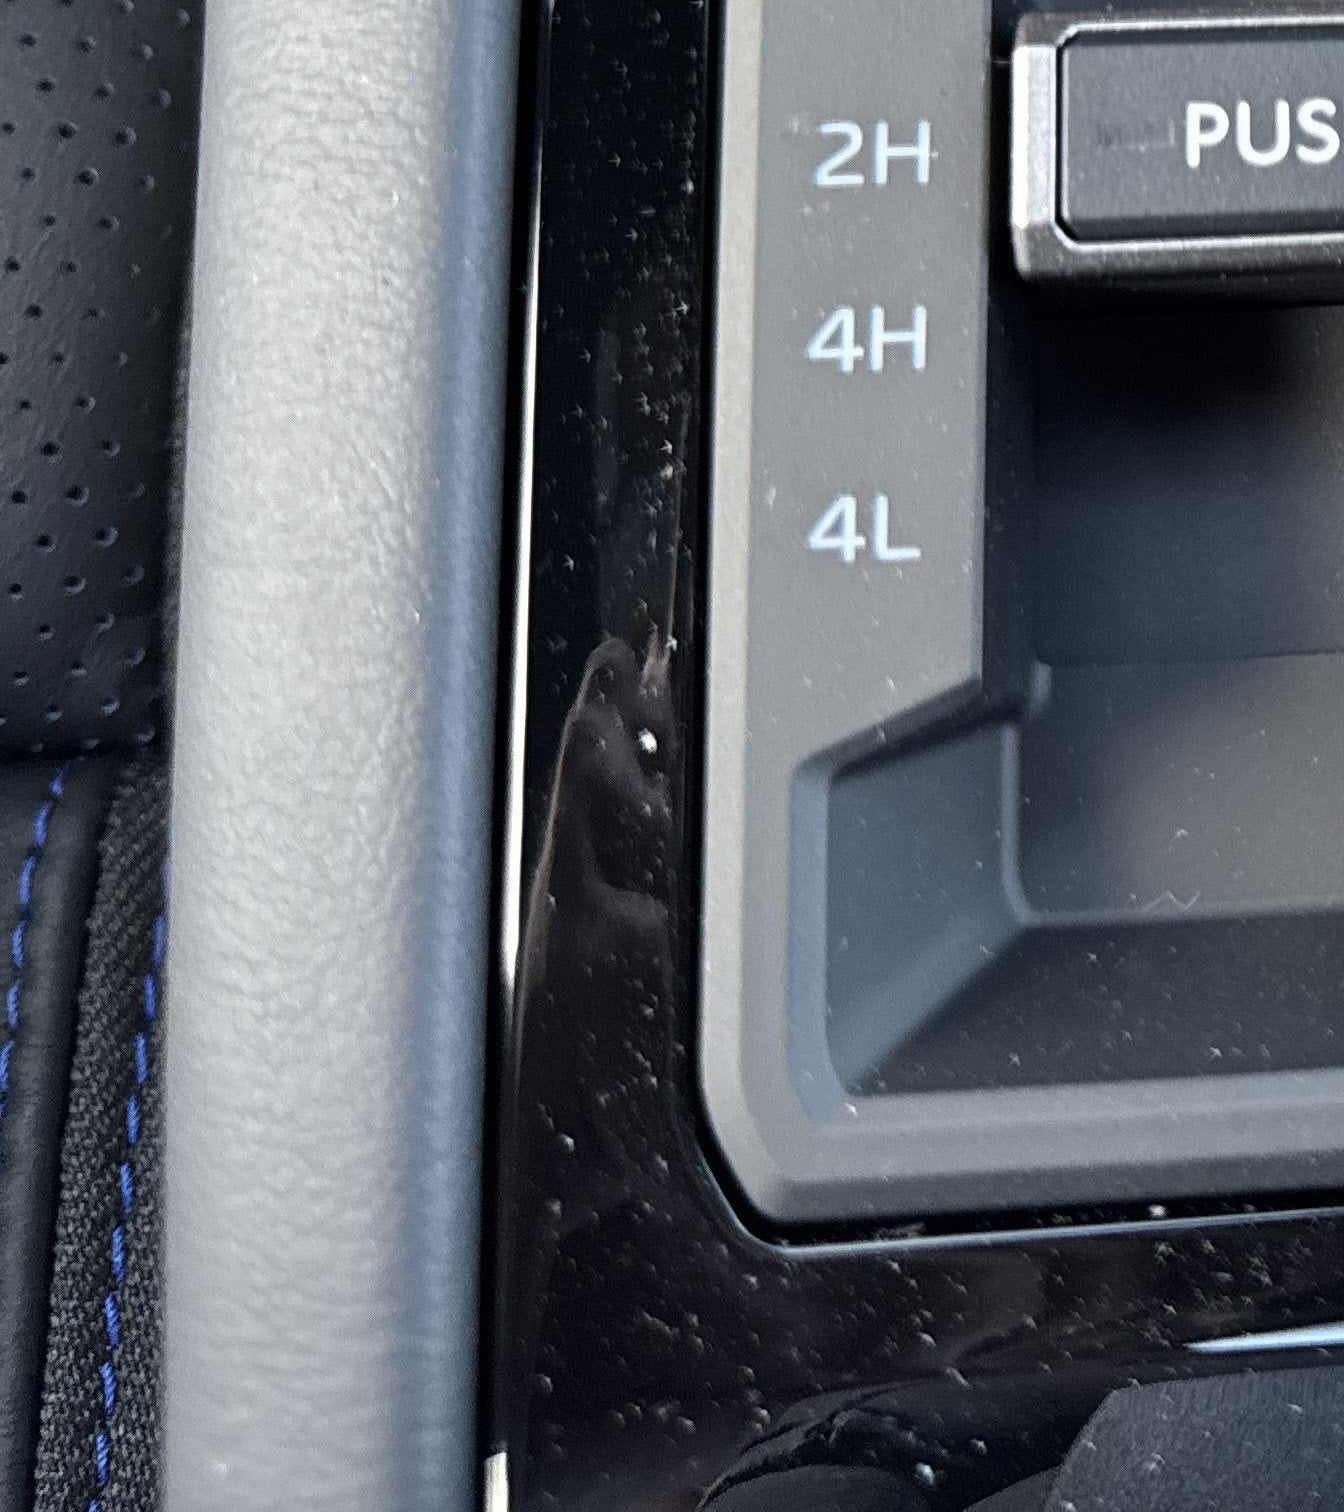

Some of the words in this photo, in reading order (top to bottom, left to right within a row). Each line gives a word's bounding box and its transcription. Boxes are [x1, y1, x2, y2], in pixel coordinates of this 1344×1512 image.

[813, 119, 932, 186] 2H
[806, 304, 928, 373] 4H
[806, 492, 922, 563] 4L
